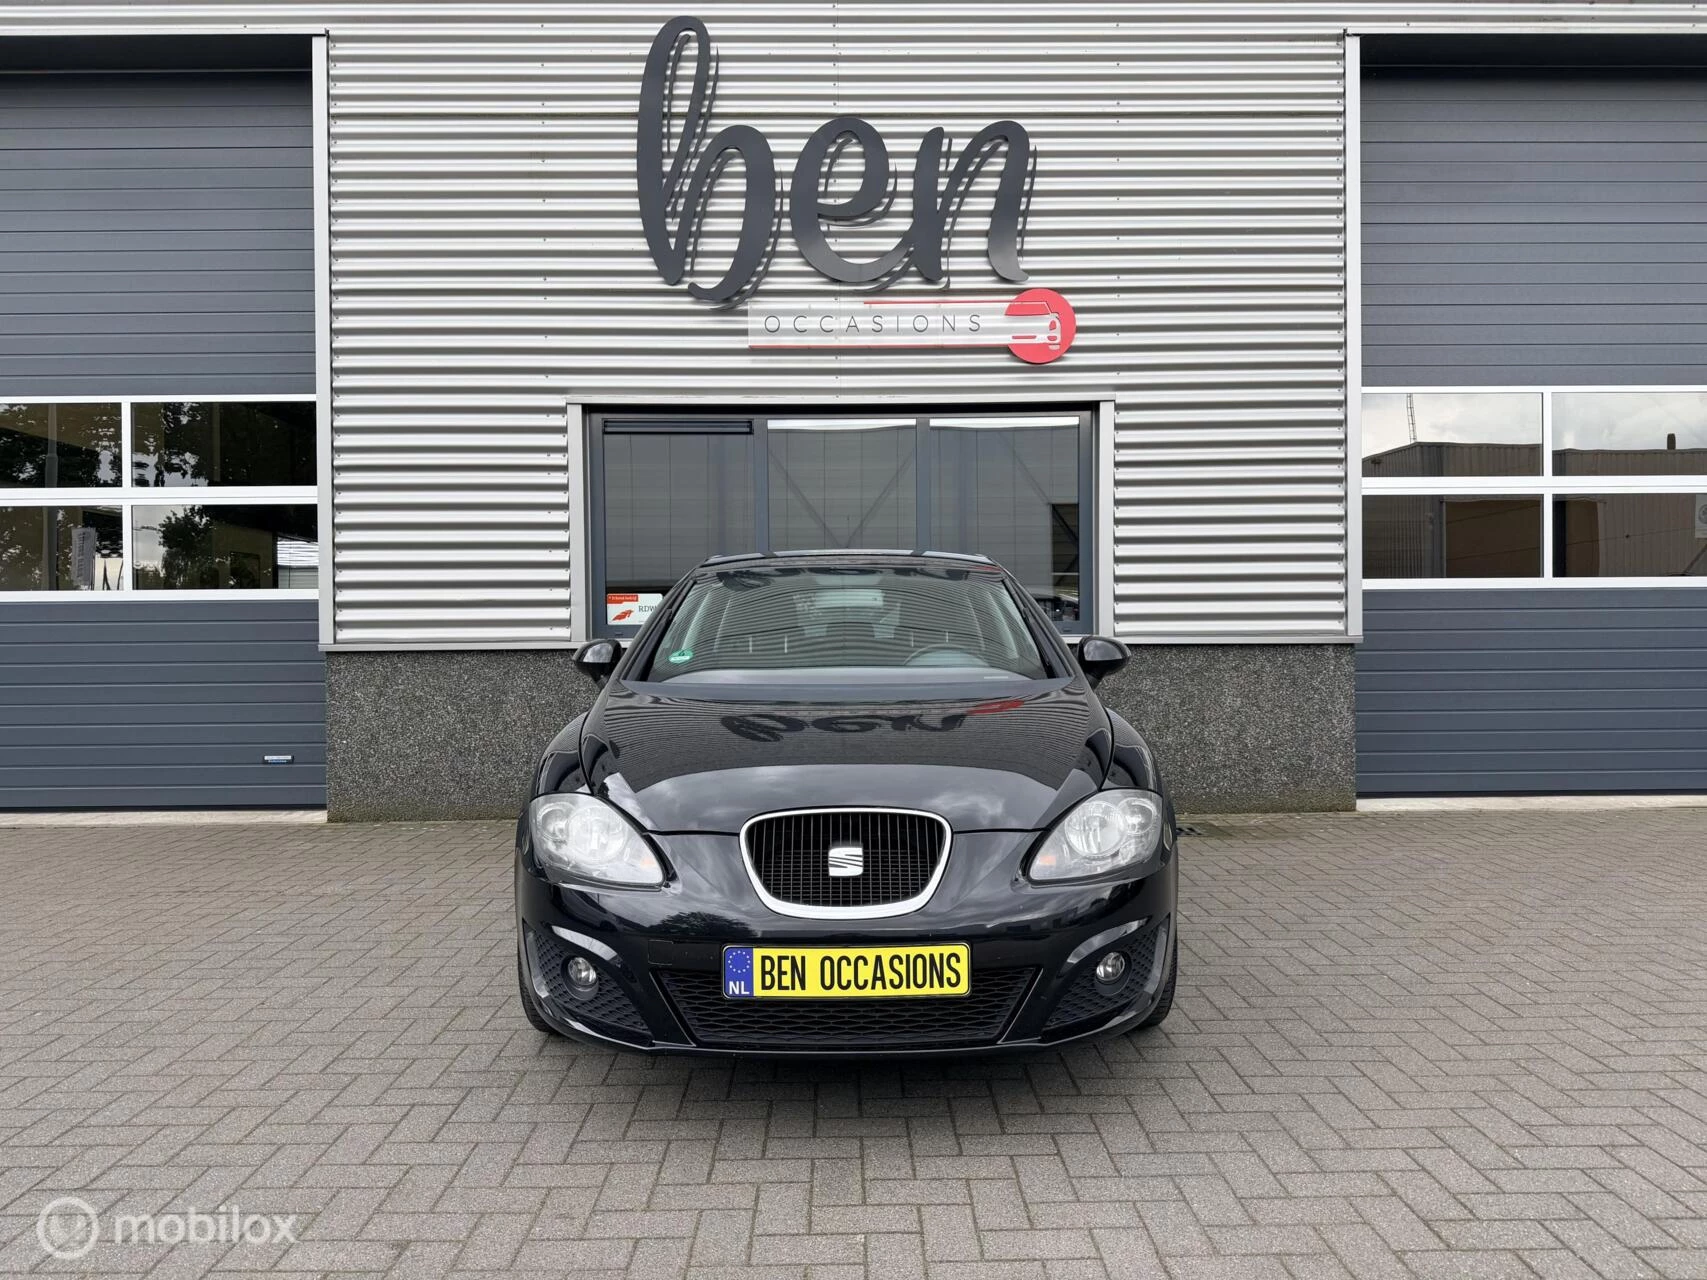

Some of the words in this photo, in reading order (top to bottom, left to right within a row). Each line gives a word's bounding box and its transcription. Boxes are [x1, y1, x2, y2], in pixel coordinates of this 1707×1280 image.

[636, 15, 1029, 301] ben
[763, 314, 982, 334] OCCASIONS
[760, 955, 806, 991] BEN
[820, 952, 961, 991] OCCASIONS
[728, 981, 750, 995] NL
